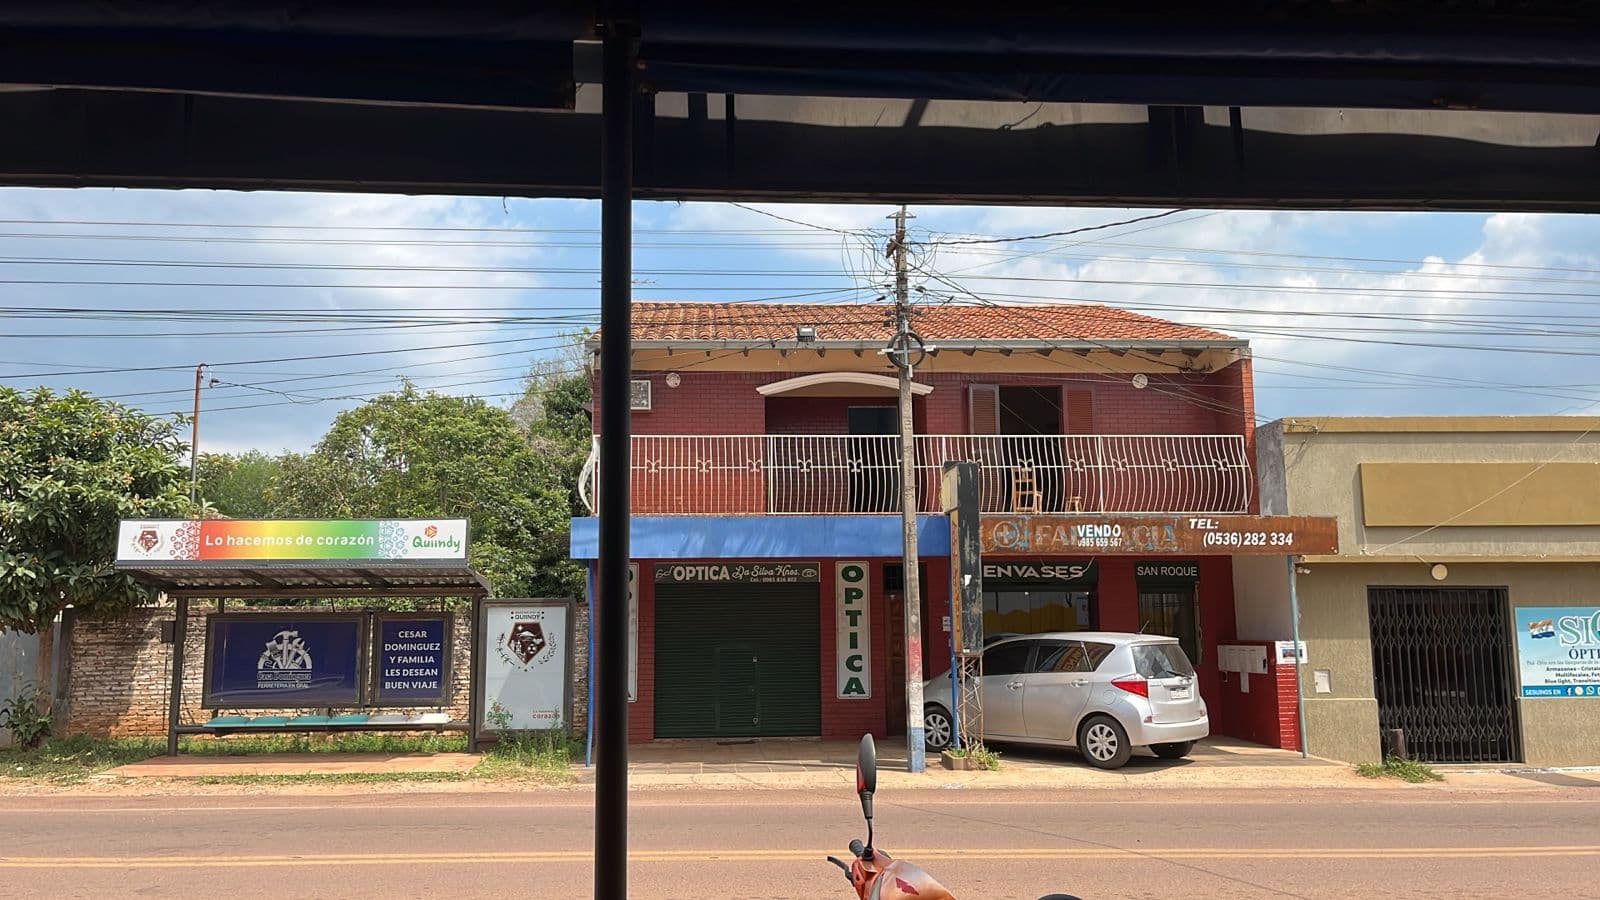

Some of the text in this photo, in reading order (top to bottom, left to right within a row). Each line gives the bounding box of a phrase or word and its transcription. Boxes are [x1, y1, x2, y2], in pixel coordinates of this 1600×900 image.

[1188, 518, 1219, 529] TEL:
[1077, 524, 1121, 538] VENDO
[205, 533, 374, 547] Lo hacemos de corazón
[412, 535, 461, 553] Quiindy
[1203, 532, 1293, 548] (0536) 282 334
[673, 565, 730, 581] OPTICA
[983, 564, 1083, 578] ENVASES
[1137, 566, 1198, 577] SAN ROQUE
[398, 630, 427, 638] CESAR
[841, 565, 866, 695] OPTICA
[384, 643, 441, 651] DOMINGUEZ
[389, 655, 435, 664] Y FAMILIA
[385, 668, 438, 677] LES DESEAN
[385, 681, 438, 689] BUEN VIAJE
